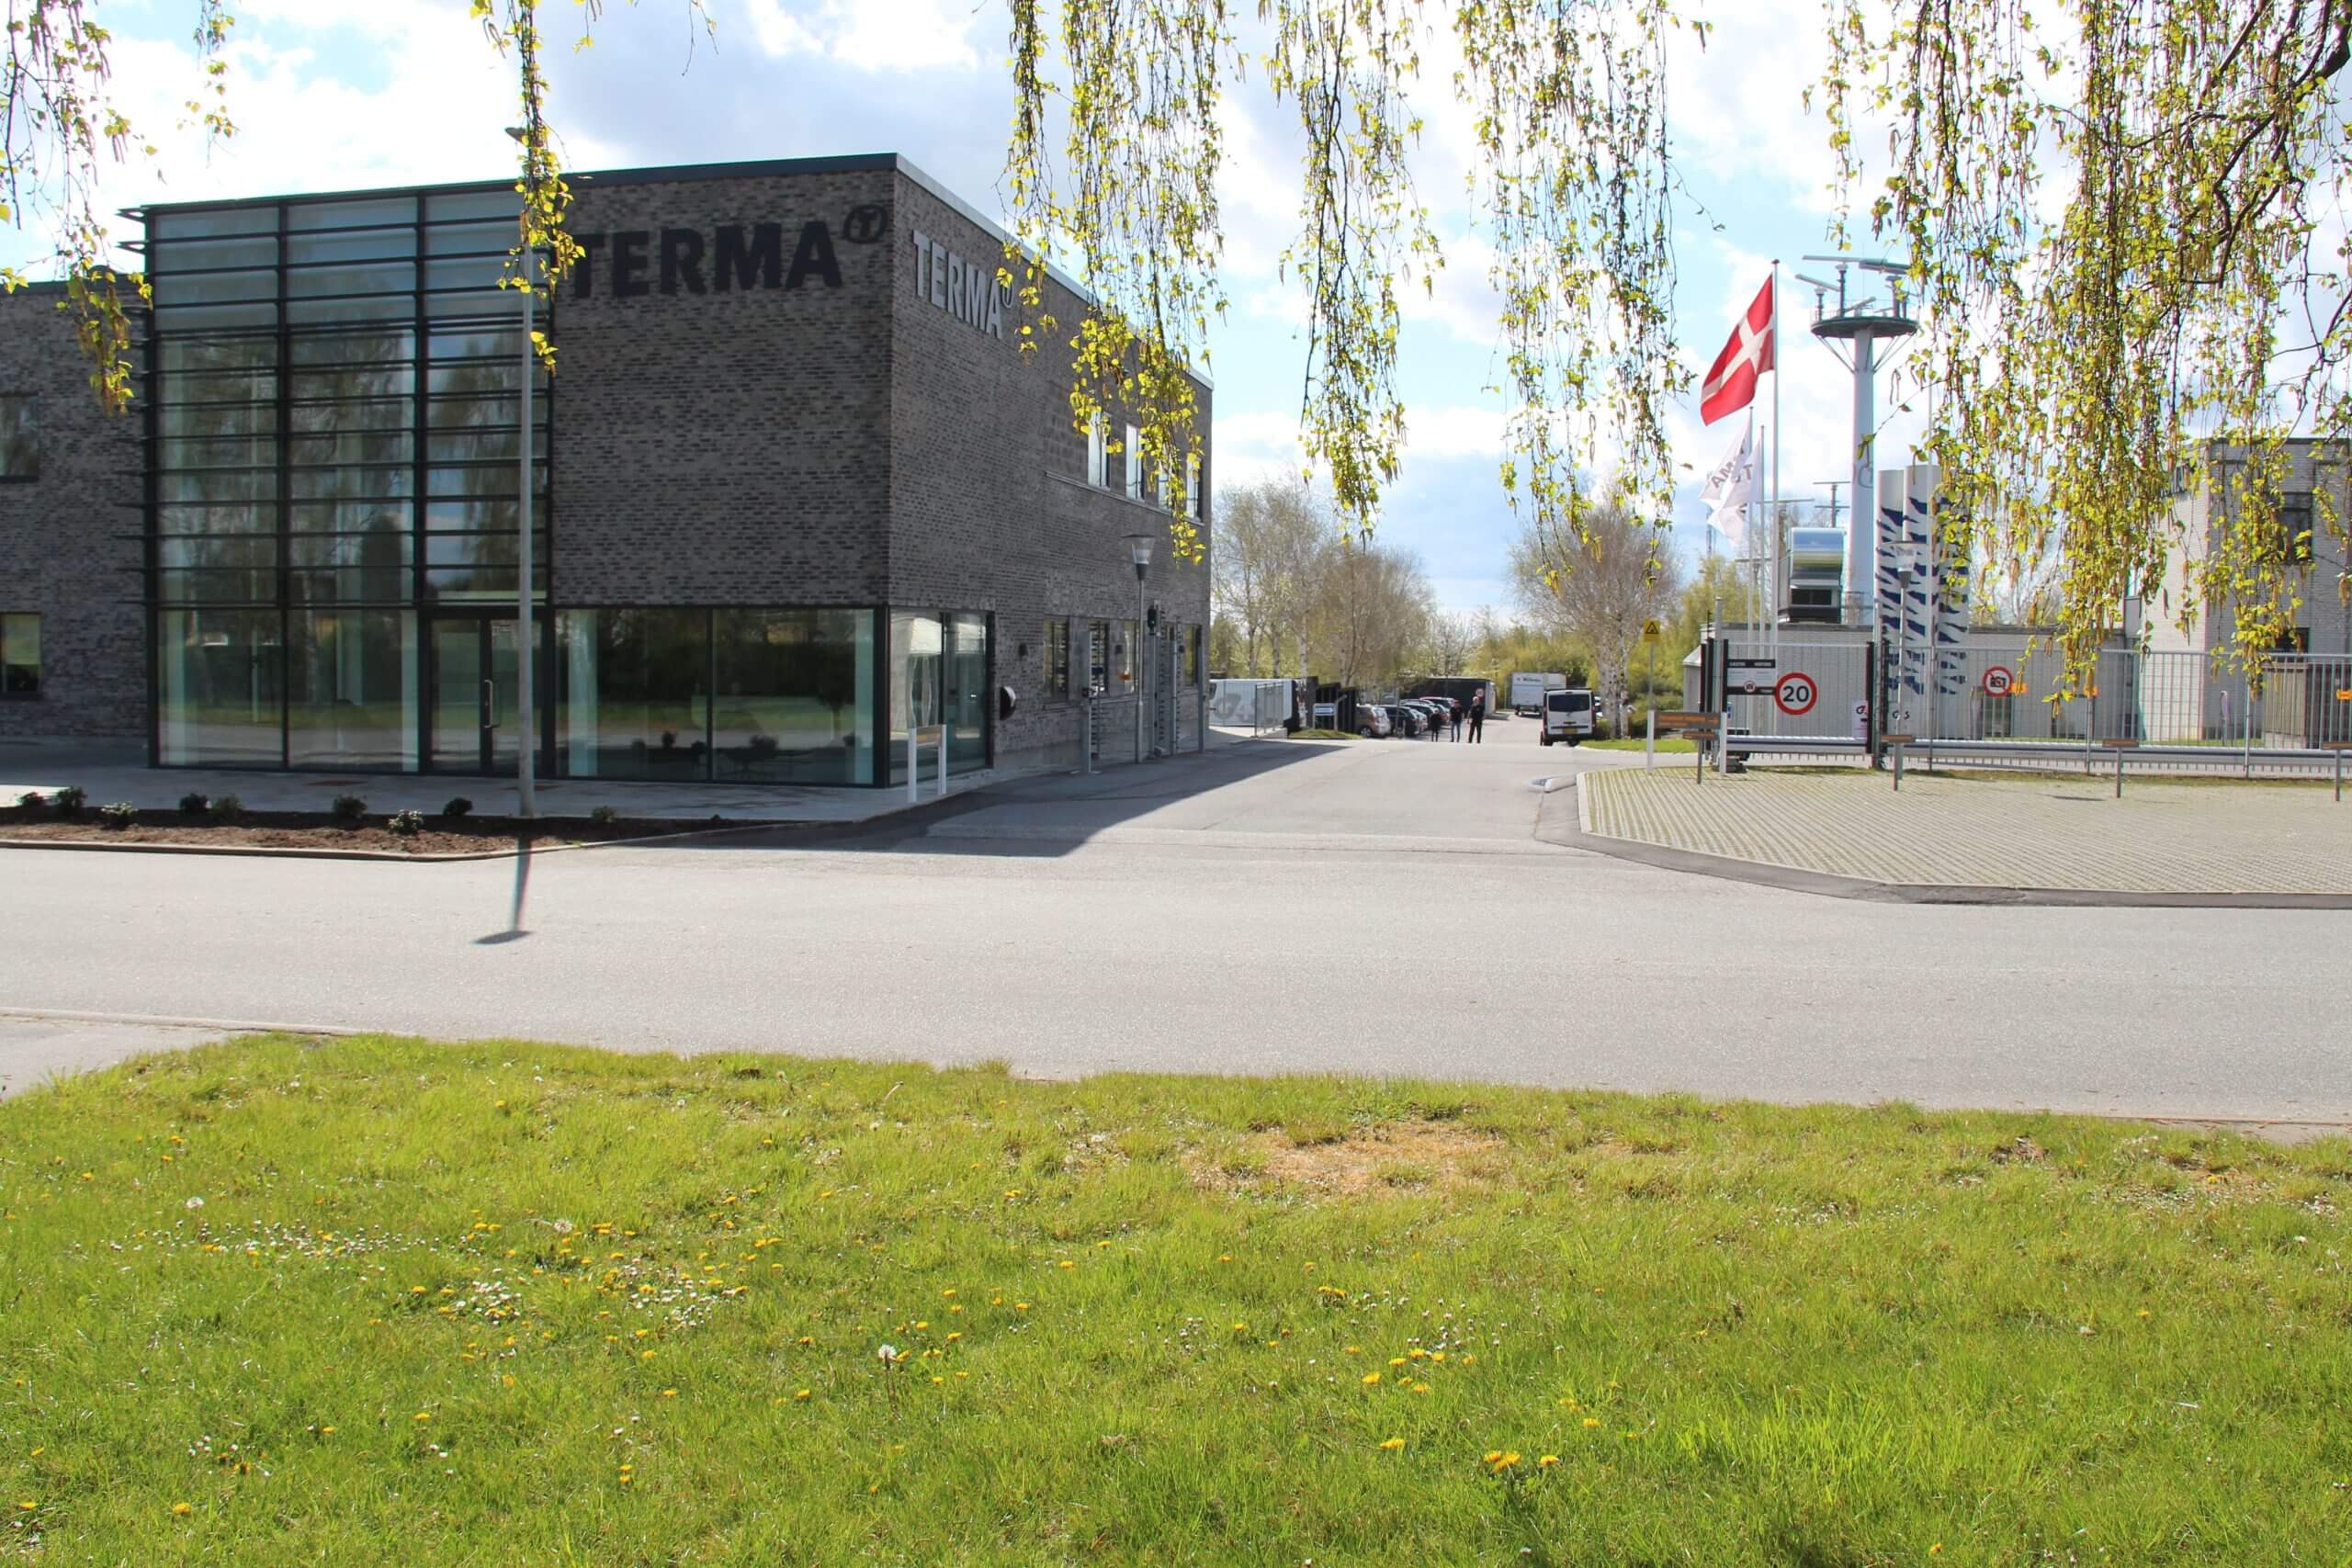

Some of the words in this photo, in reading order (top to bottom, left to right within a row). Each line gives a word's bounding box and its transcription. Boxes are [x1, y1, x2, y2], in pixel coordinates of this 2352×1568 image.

[568, 220, 842, 299] TERMA
[912, 230, 1002, 340] TERMA
[1783, 685, 1809, 703] 20
